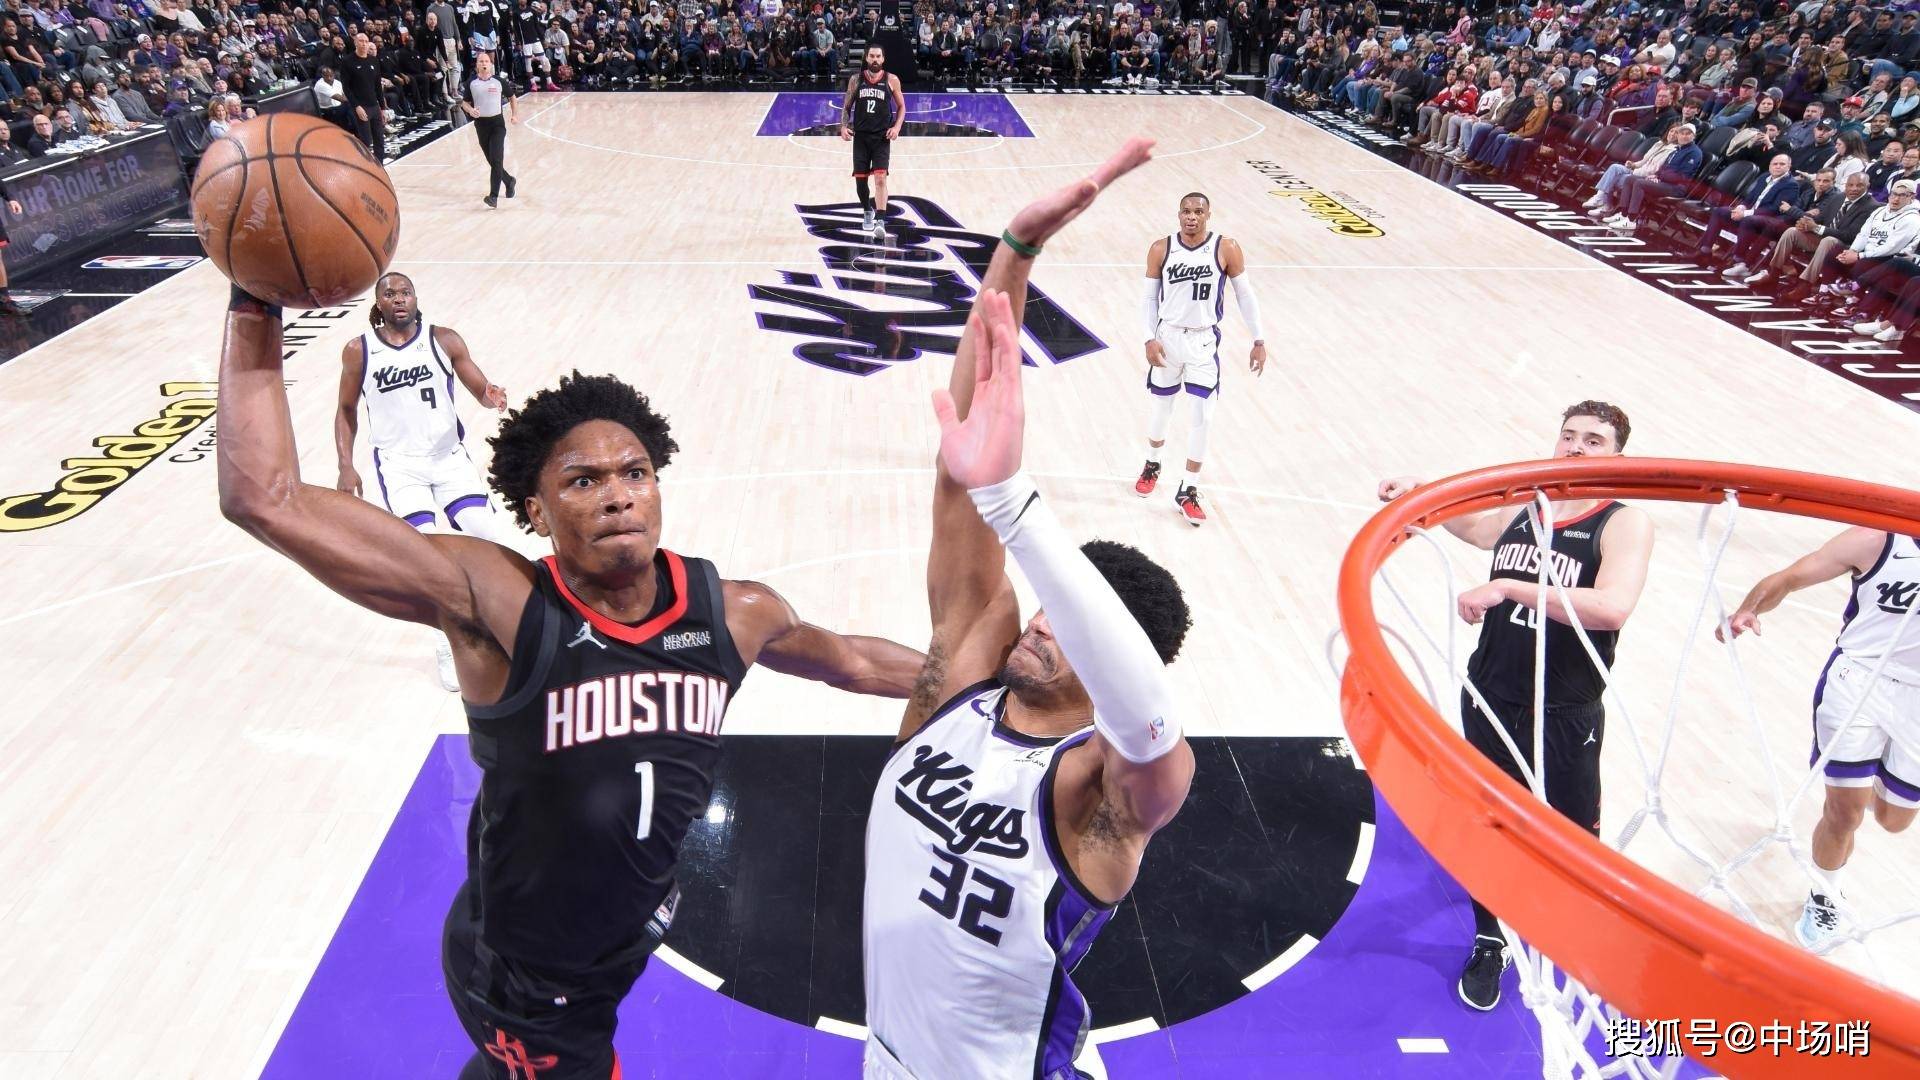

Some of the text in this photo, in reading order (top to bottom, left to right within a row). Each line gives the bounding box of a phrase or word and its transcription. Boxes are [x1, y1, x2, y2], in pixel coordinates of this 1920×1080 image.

[859, 88, 885, 100] HOUSTON
[867, 100, 876, 113] 12
[50, 165, 107, 208] HOME
[107, 154, 141, 189] FOR
[1246, 160, 1314, 190] CENTER
[1455, 183, 1613, 230] PROUD
[747, 195, 1109, 377] Kings
[1167, 263, 1213, 284] Kings
[1192, 282, 1212, 301] 18
[373, 364, 434, 394] Kings
[420, 387, 437, 409] 9
[663, 631, 711, 644] MEMORIAL
[663, 638, 711, 650] HERMANN
[544, 670, 729, 754] HOUSTON
[634, 761, 655, 840] 1
[918, 843, 1016, 948] 32
